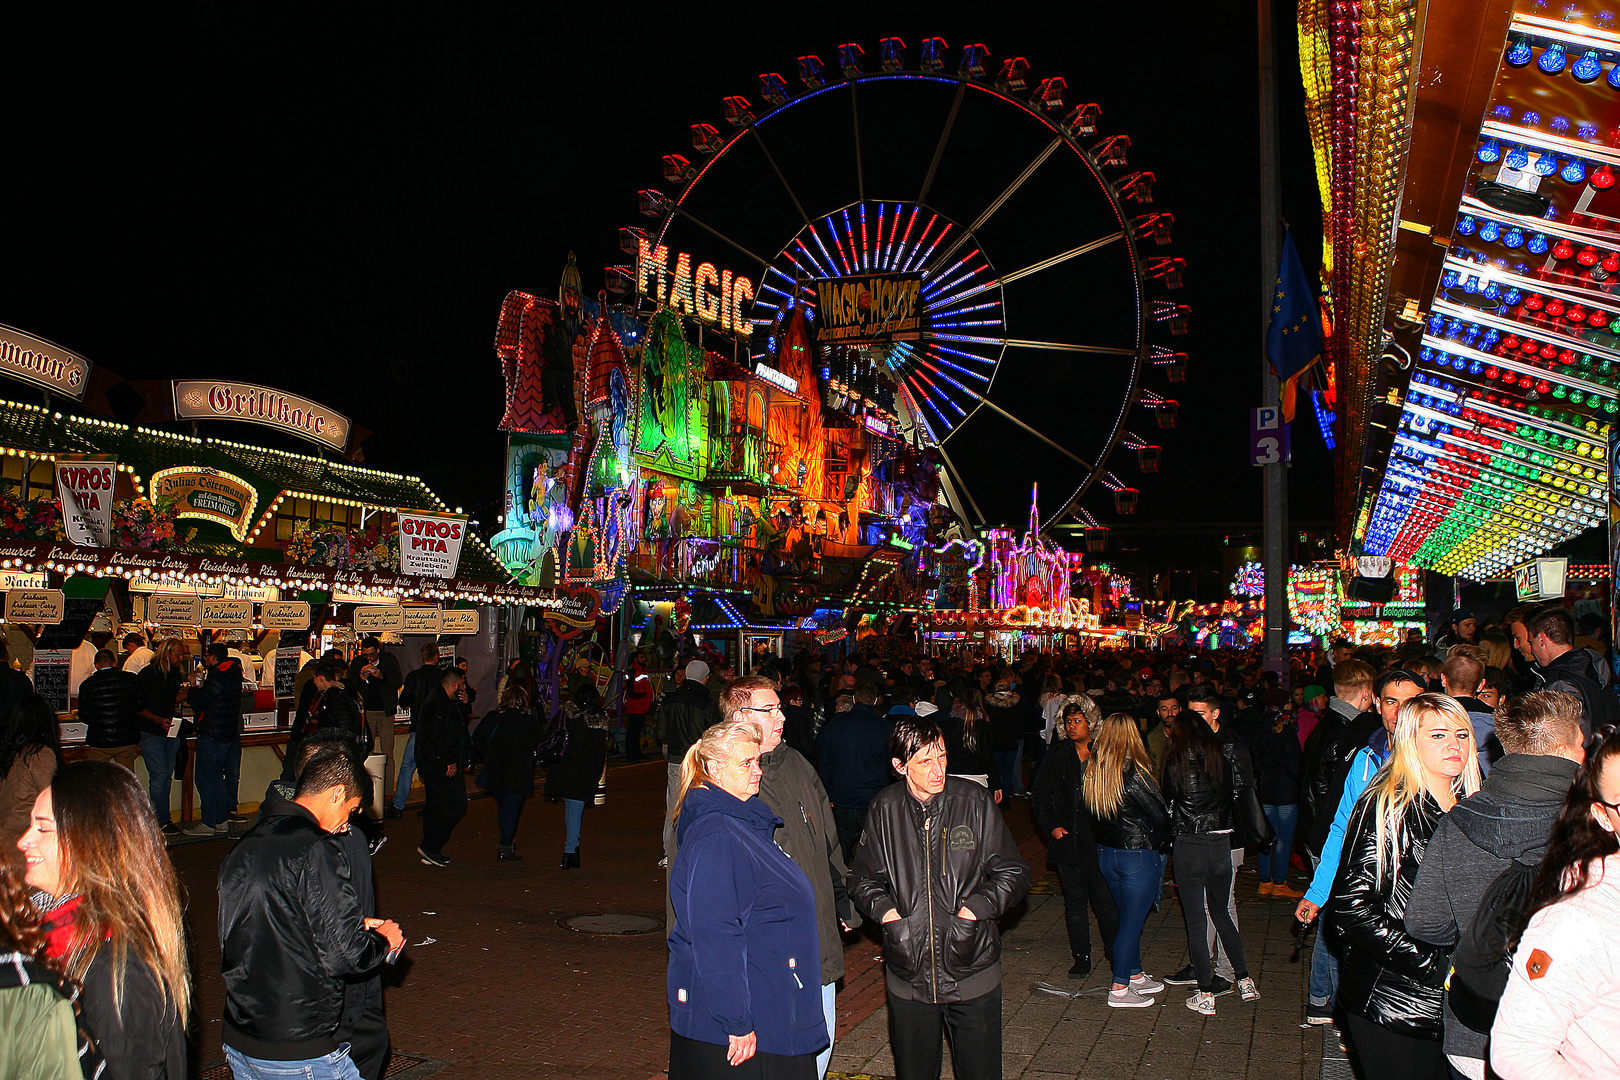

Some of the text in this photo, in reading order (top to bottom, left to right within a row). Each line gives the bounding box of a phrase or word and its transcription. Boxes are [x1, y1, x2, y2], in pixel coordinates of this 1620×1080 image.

[638, 238, 754, 336] MAGIC
[817, 278, 921, 329] MAGIC HOUSE
[817, 326, 845, 341] ACTION
[845, 325, 861, 338] PUR
[887, 317, 916, 332] ETAGEN
[0, 341, 82, 387] mann's
[207, 383, 326, 435] Grillkate
[1260, 408, 1275, 428] P
[1256, 436, 1280, 464] 3
[60, 466, 112, 490] GYROS
[164, 476, 197, 491] Julius
[198, 476, 245, 501] Ostermann
[193, 498, 237, 516] FREIMARKT
[402, 518, 460, 539] GYROS
[412, 537, 448, 553] PITA
[0, 547, 37, 558] wurst
[47, 546, 100, 562] Krakauer
[109, 551, 189, 573] Krakauer-Curry
[259, 564, 278, 577] Pilze
[286, 565, 326, 583] Hamburger
[334, 570, 348, 582] Hot
[349, 571, 363, 585] Dog
[419, 577, 448, 592] Gyros-Pita
[406, 554, 452, 565] Krautsalat,
[410, 561, 448, 570] Zwiebeln
[691, 551, 720, 578] ACTION
[203, 606, 248, 620] Bratwurst
[266, 608, 306, 618] Nackensteaks
[552, 605, 588, 619] eimaak
[1343, 606, 1374, 617] Spaghetti
